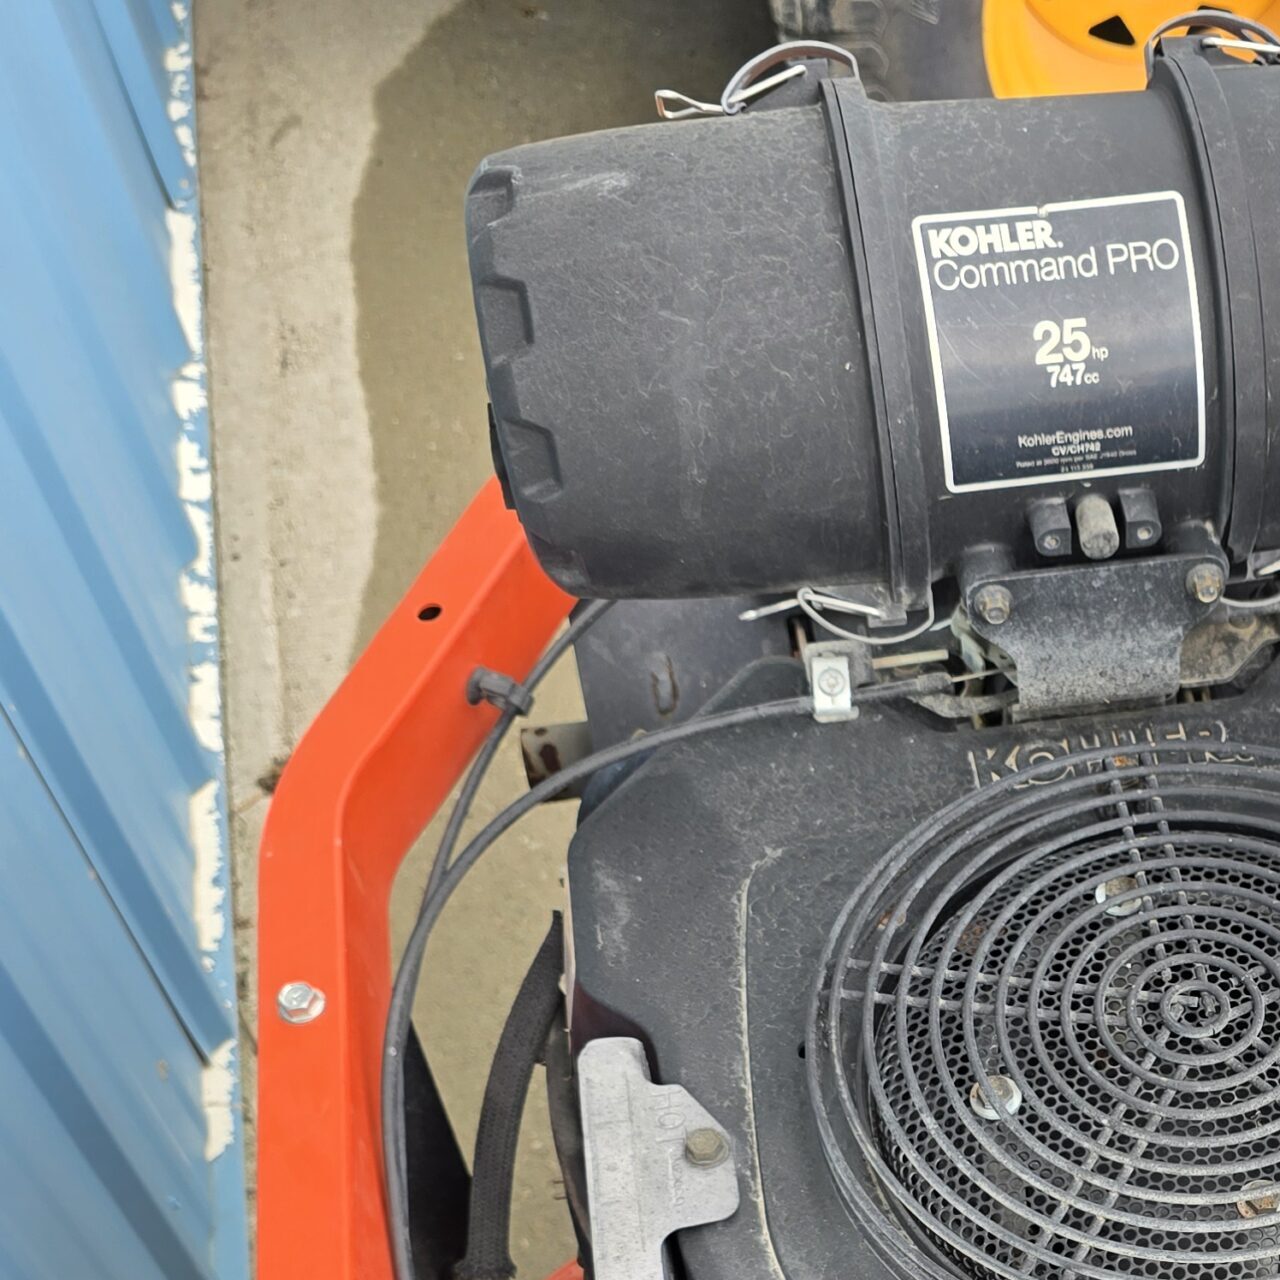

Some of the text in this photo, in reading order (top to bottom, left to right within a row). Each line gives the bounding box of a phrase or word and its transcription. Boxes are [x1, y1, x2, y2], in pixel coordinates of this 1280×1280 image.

[933, 238, 1179, 291] Command PRO
[1018, 425, 1133, 448] KohlerEngines.com
